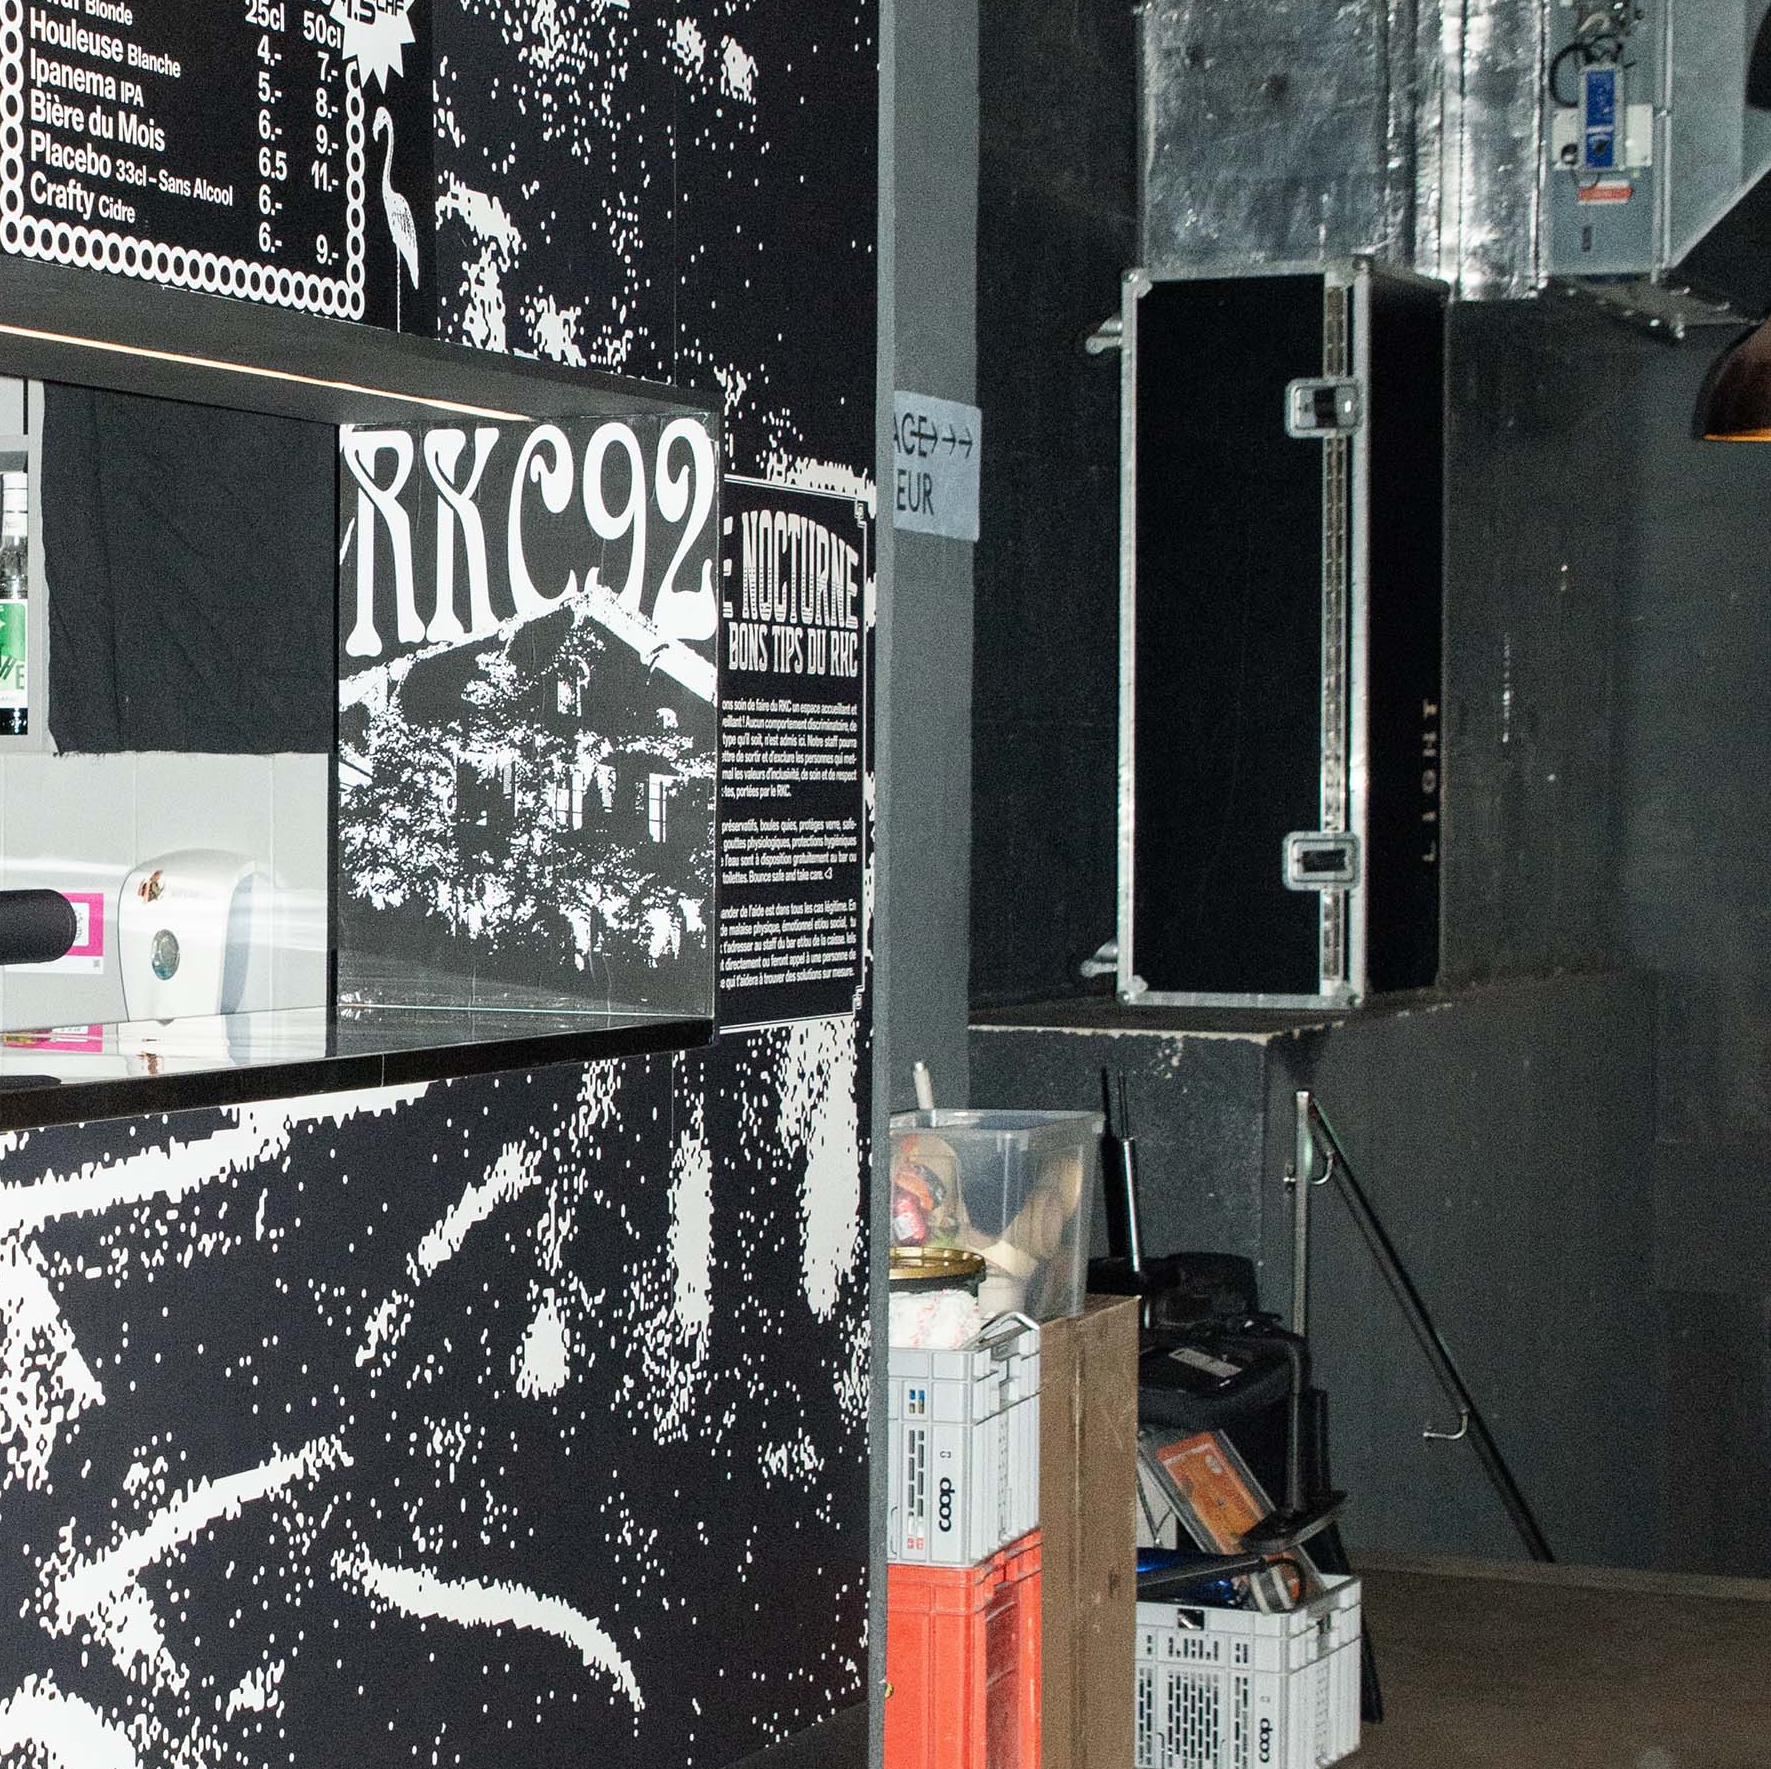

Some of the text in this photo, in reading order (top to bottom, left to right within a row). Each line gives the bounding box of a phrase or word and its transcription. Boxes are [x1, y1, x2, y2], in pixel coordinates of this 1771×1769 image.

[30, 7, 124, 62] Houleuse
[128, 43, 181, 78] Blanche
[303, 9, 342, 50] 50cl
[30, 48, 116, 101] Ipanema
[121, 81, 145, 108] IPA
[30, 89, 85, 132] Bière
[88, 104, 114, 140] du
[118, 110, 166, 152] Mois
[257, 147, 288, 182] 6.5
[30, 129, 112, 179] Placebo
[115, 159, 147, 187] 33cl
[158, 169, 192, 198] Sans
[193, 181, 234, 207] Alcool
[30, 170, 95, 221] Crafty
[98, 195, 136, 224] Cidre
[897, 468, 934, 516] EUR
[344, 417, 717, 658] RKC92
[741, 510, 859, 629] NOCTURNE
[728, 621, 768, 672] BONS
[772, 625, 803, 674] TIPS
[807, 628, 826, 676] DU
[748, 870, 772, 883] Bounce
[771, 869, 784, 882] safe
[785, 869, 796, 881] and
[796, 868, 809, 881] take
[939, 1477, 955, 1532] coop
[1259, 1717, 1275, 1763] coop
